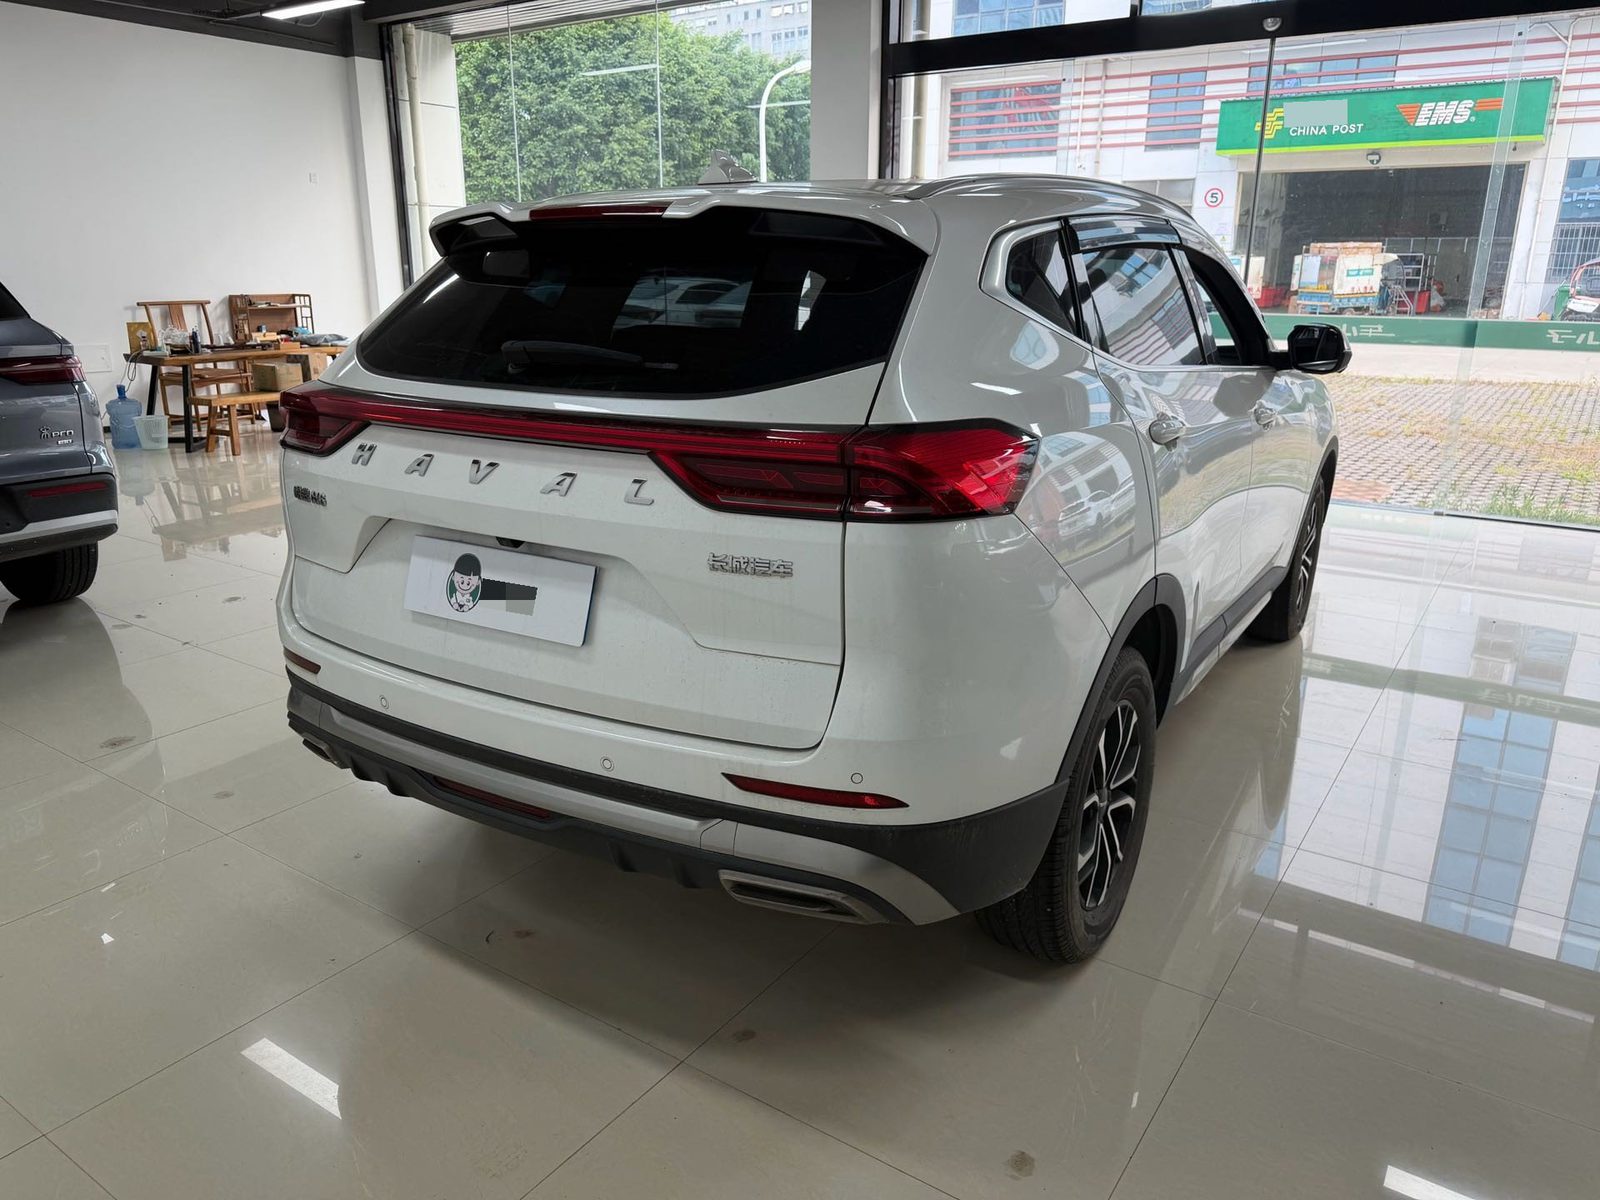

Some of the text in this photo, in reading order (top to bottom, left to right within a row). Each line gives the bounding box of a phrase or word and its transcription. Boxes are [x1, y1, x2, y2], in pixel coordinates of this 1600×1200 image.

[1415, 99, 1474, 126] EMS
[1289, 123, 1364, 136] CHINA POST
[351, 443, 655, 506] HAVAL
[707, 552, 794, 578] 长城汽车
